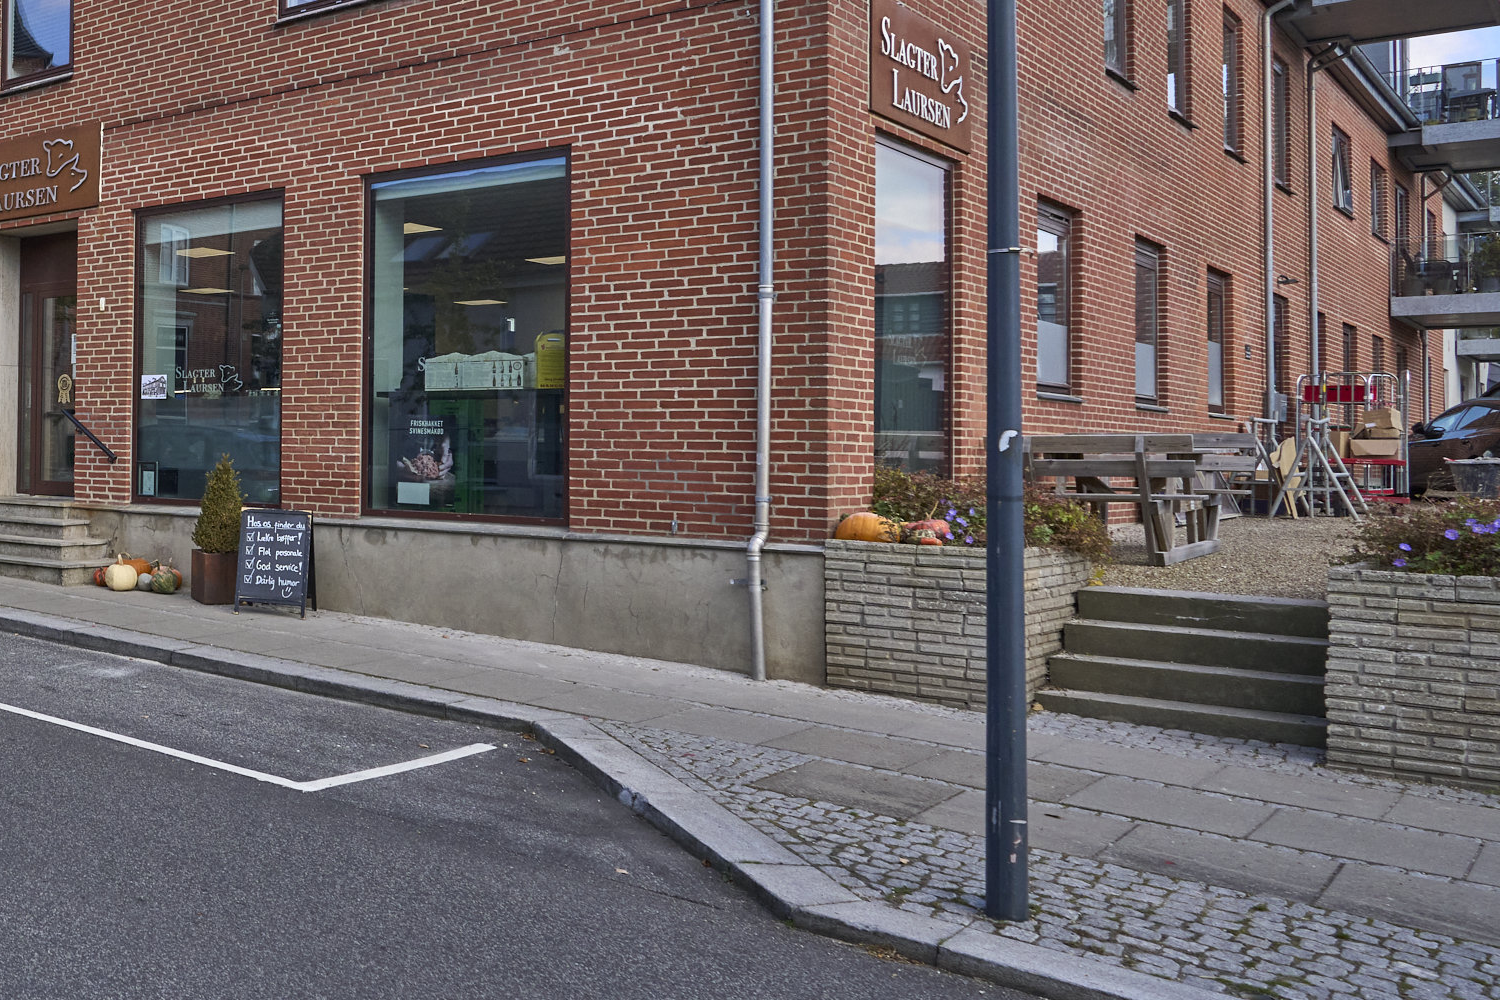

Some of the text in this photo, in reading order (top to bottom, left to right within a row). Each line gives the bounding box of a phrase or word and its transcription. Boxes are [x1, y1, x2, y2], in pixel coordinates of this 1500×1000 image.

[881, 16, 938, 81] SLAGTER
[892, 68, 951, 129] LAURSEN
[175, 366, 216, 379] SLAGTER
[183, 381, 224, 393] LAURSEN
[410, 419, 443, 427] FRISKHAKKET
[274, 520, 295, 534] finder
[295, 521, 306, 530] du
[275, 550, 303, 560] personale
[256, 560, 271, 571] God
[255, 574, 300, 590] Dårlig humor
